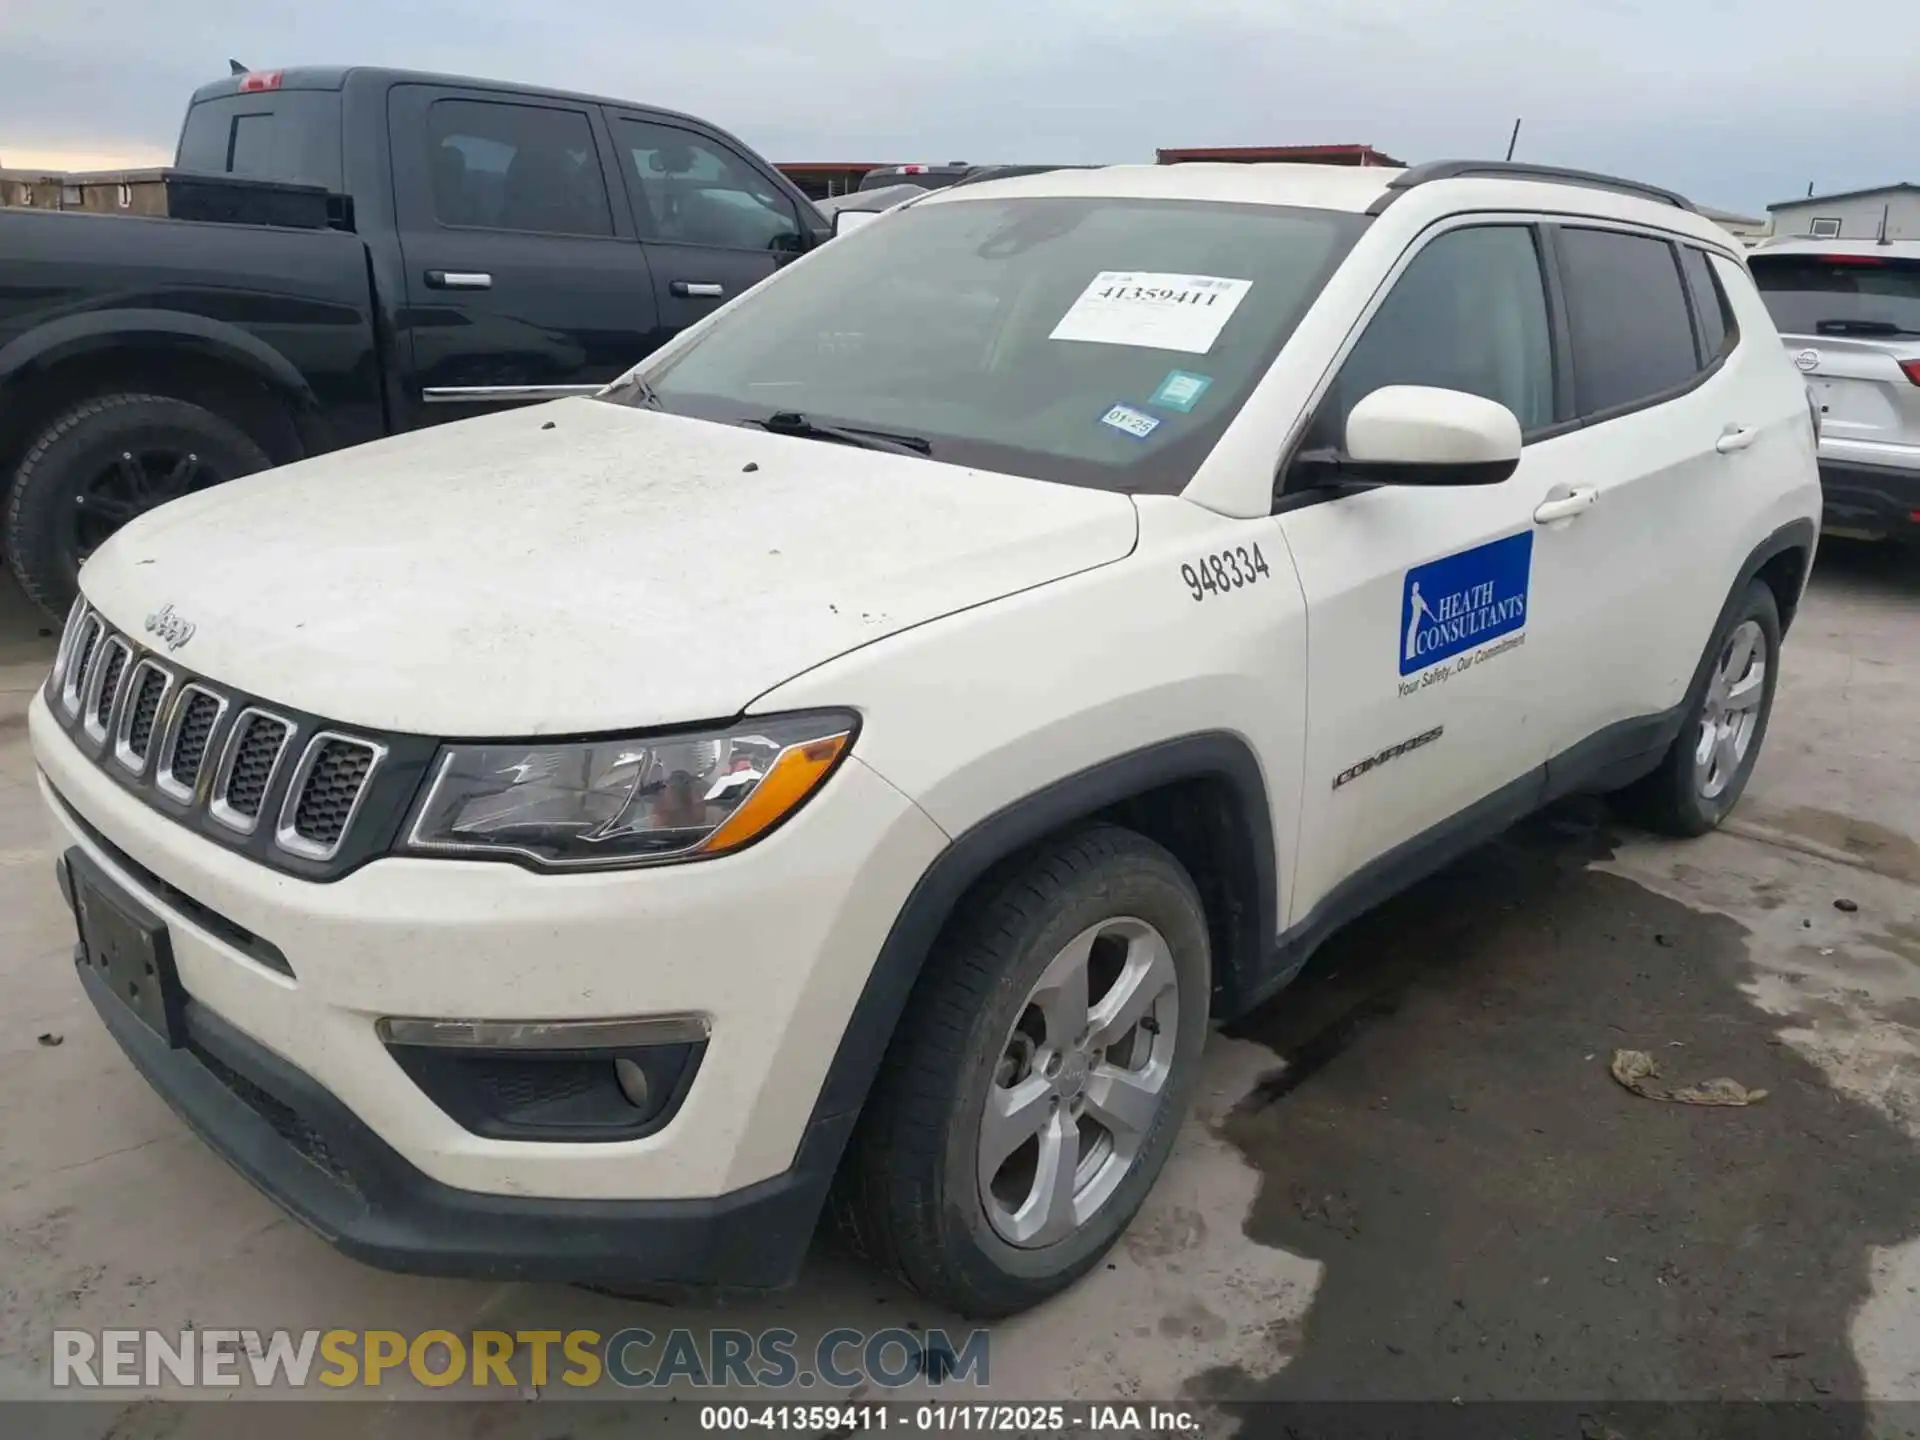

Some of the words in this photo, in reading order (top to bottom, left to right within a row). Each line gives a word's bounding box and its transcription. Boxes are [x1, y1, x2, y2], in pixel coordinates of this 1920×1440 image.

[1098, 286, 1219, 306] 41359411
[1181, 541, 1270, 602] 948334
[1416, 593, 1525, 656] CONSULTANTS
[1438, 580, 1494, 622] HEATH
[144, 603, 197, 651] Jeep
[1398, 679, 1420, 698] Your
[1332, 724, 1444, 790] COMPASS
